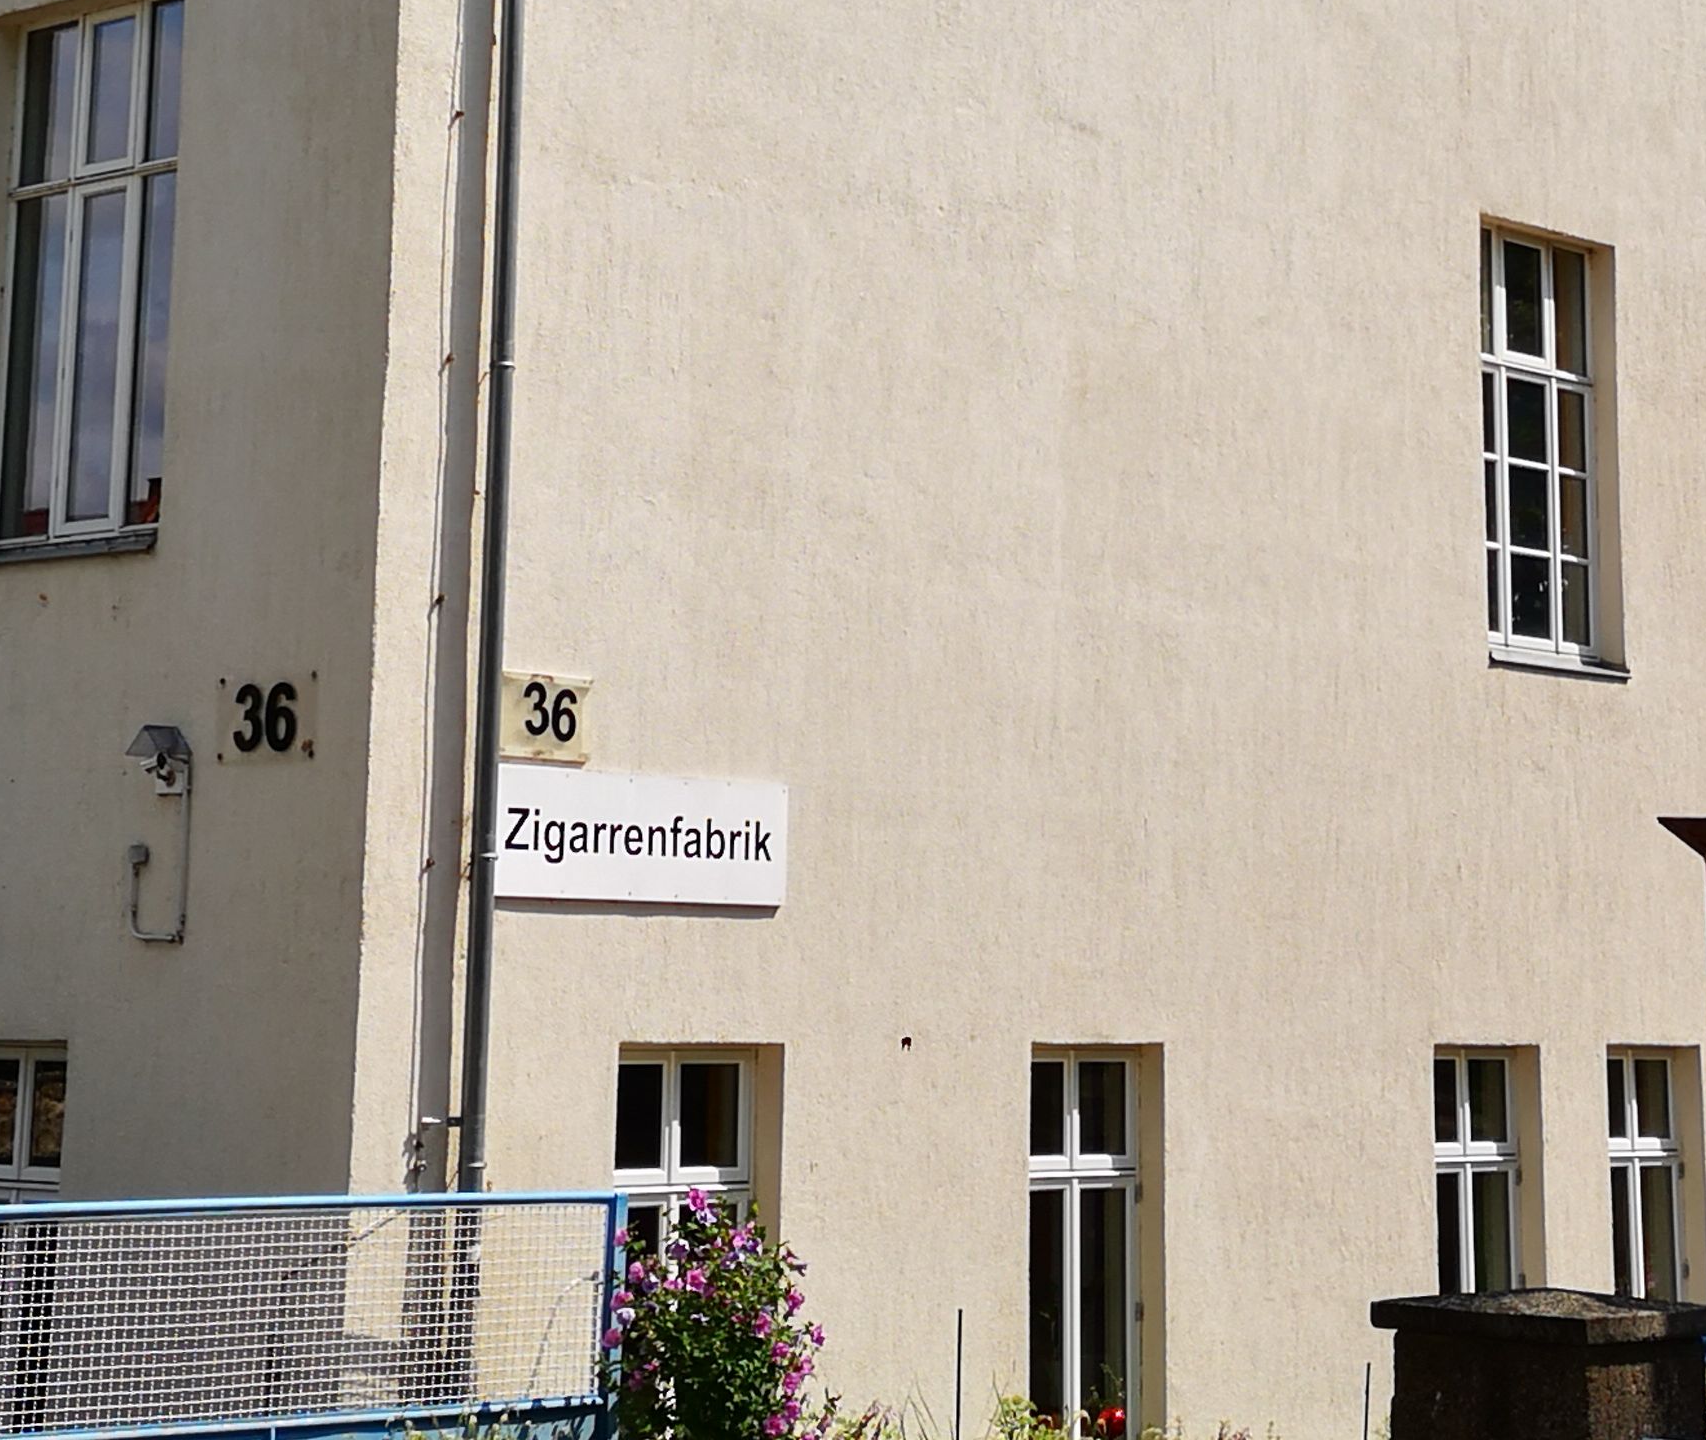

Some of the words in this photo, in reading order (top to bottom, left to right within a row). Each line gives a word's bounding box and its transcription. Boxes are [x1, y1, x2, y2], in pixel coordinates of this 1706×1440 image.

[232, 681, 299, 753] 36
[523, 680, 579, 743] 36
[503, 806, 773, 865] Zigarrenfabrik
